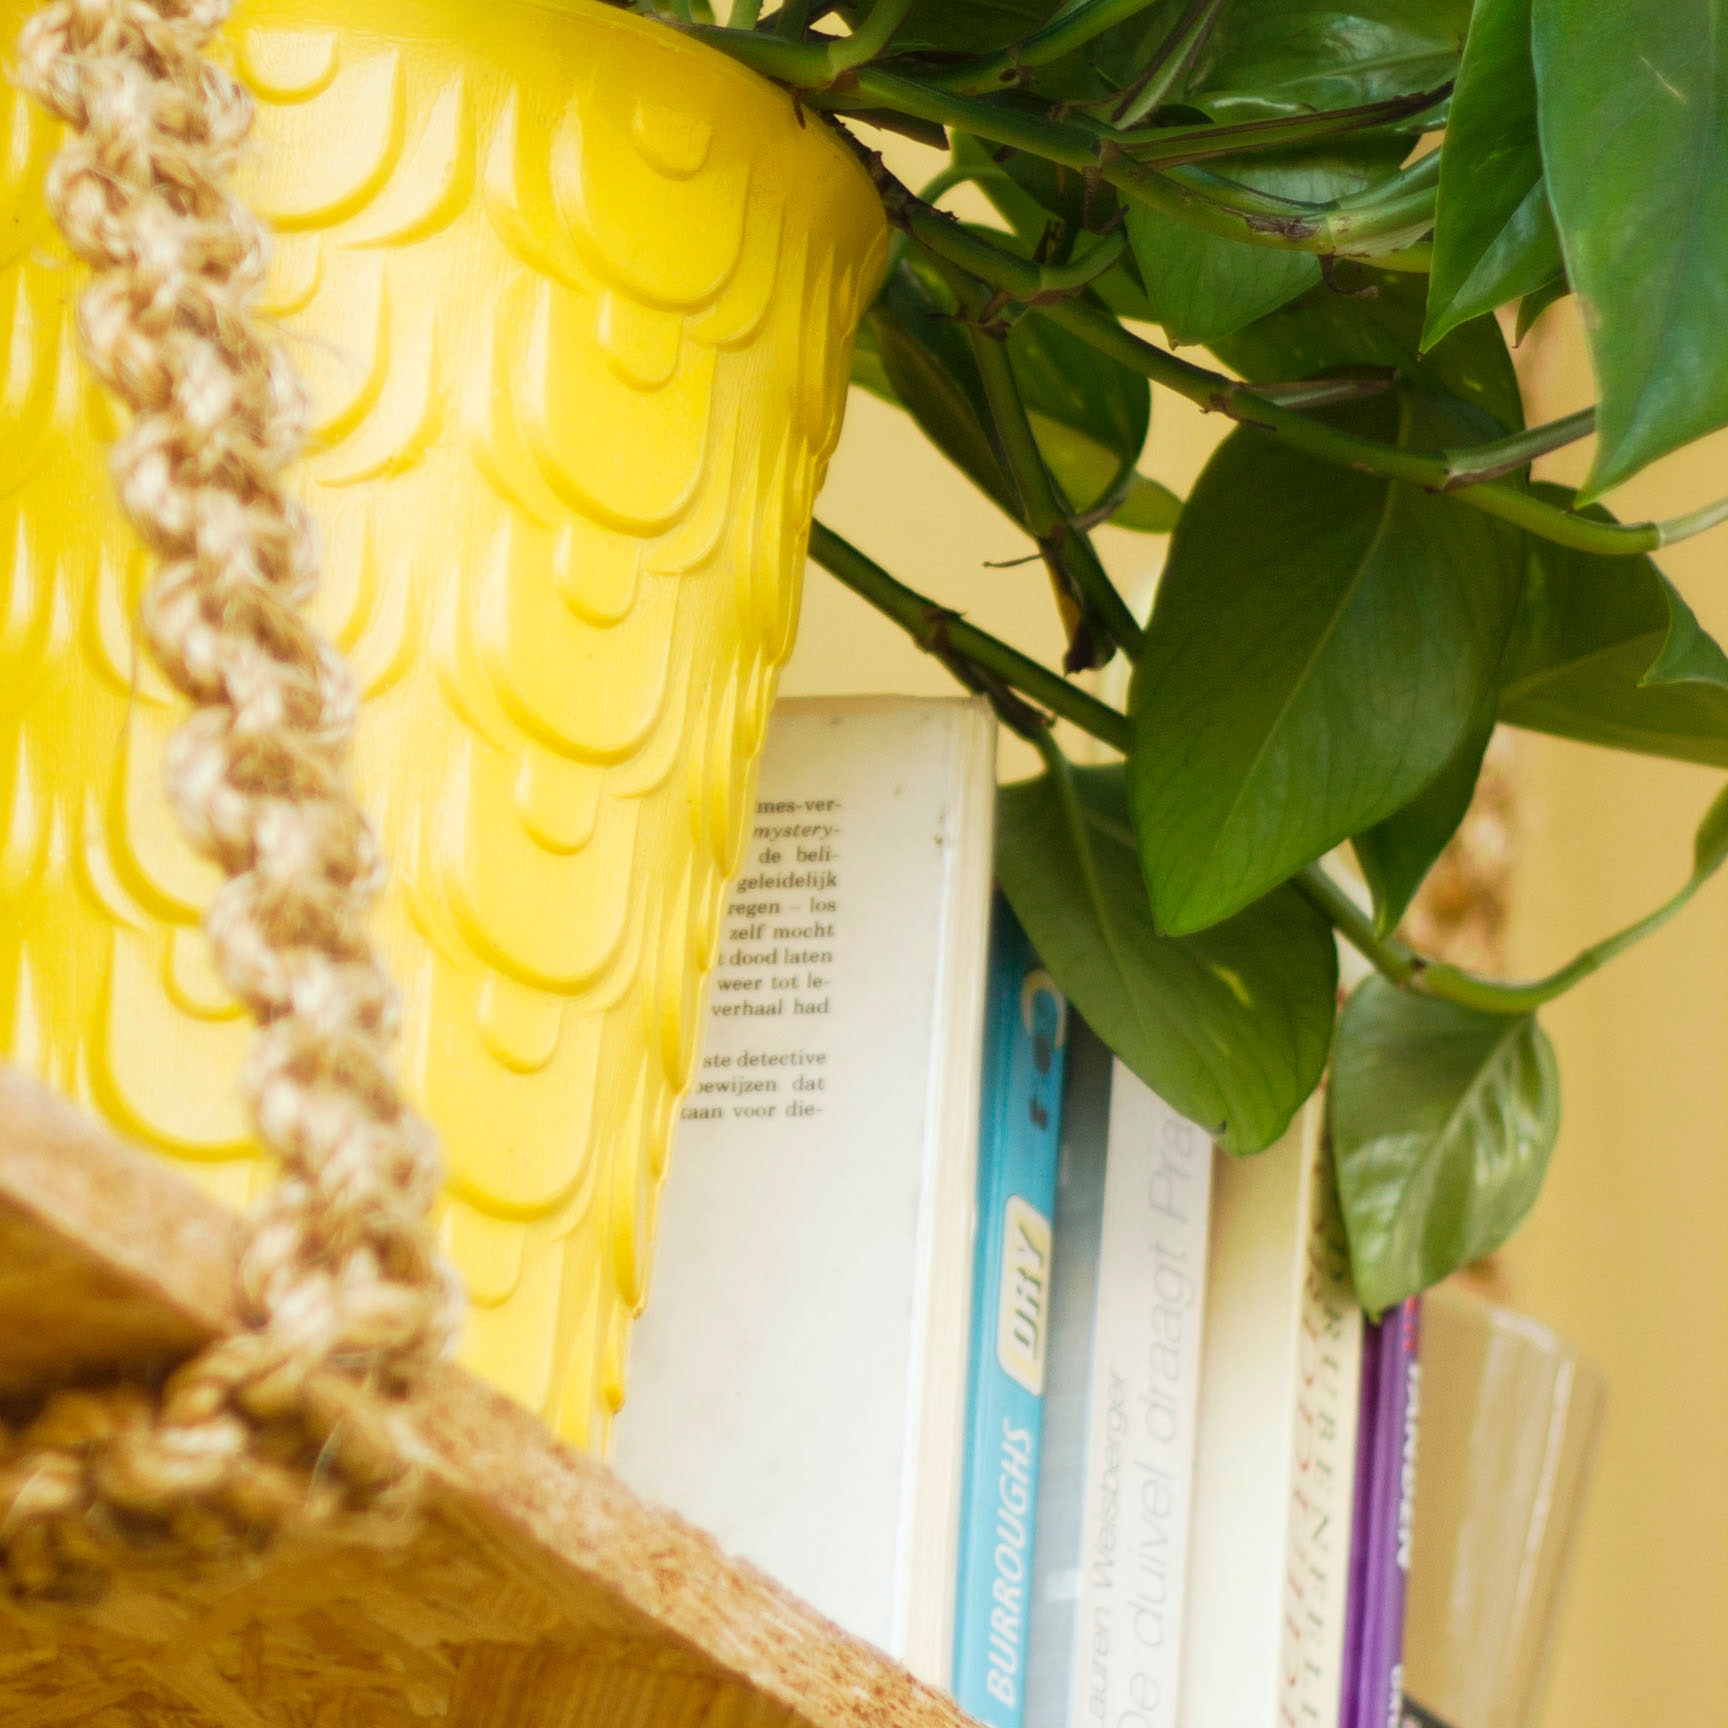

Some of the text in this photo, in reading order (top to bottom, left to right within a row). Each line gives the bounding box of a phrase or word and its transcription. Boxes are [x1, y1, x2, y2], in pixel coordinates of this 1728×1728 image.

[753, 824, 840, 841] mystery-
[758, 845, 840, 864] de beli-
[736, 870, 837, 894] geleidelijk
[728, 901, 780, 918] regen
[810, 896, 837, 913] los
[729, 921, 834, 940] zelf mocht
[729, 948, 777, 966] dood
[784, 948, 832, 964] laten
[716, 972, 830, 991] weer tot le-
[711, 997, 829, 1017] verhaal had
[736, 1049, 827, 1067] detective
[791, 1074, 825, 1091] dat
[733, 1105, 776, 1119] voor
[785, 1100, 824, 1118] die-
[1135, 1239, 1196, 1445] draagt
[985, 1218, 1045, 1710] BURROUGHS DRY
[1092, 1367, 1130, 1590] Weisberger
[1126, 1459, 1174, 1649] duivel
